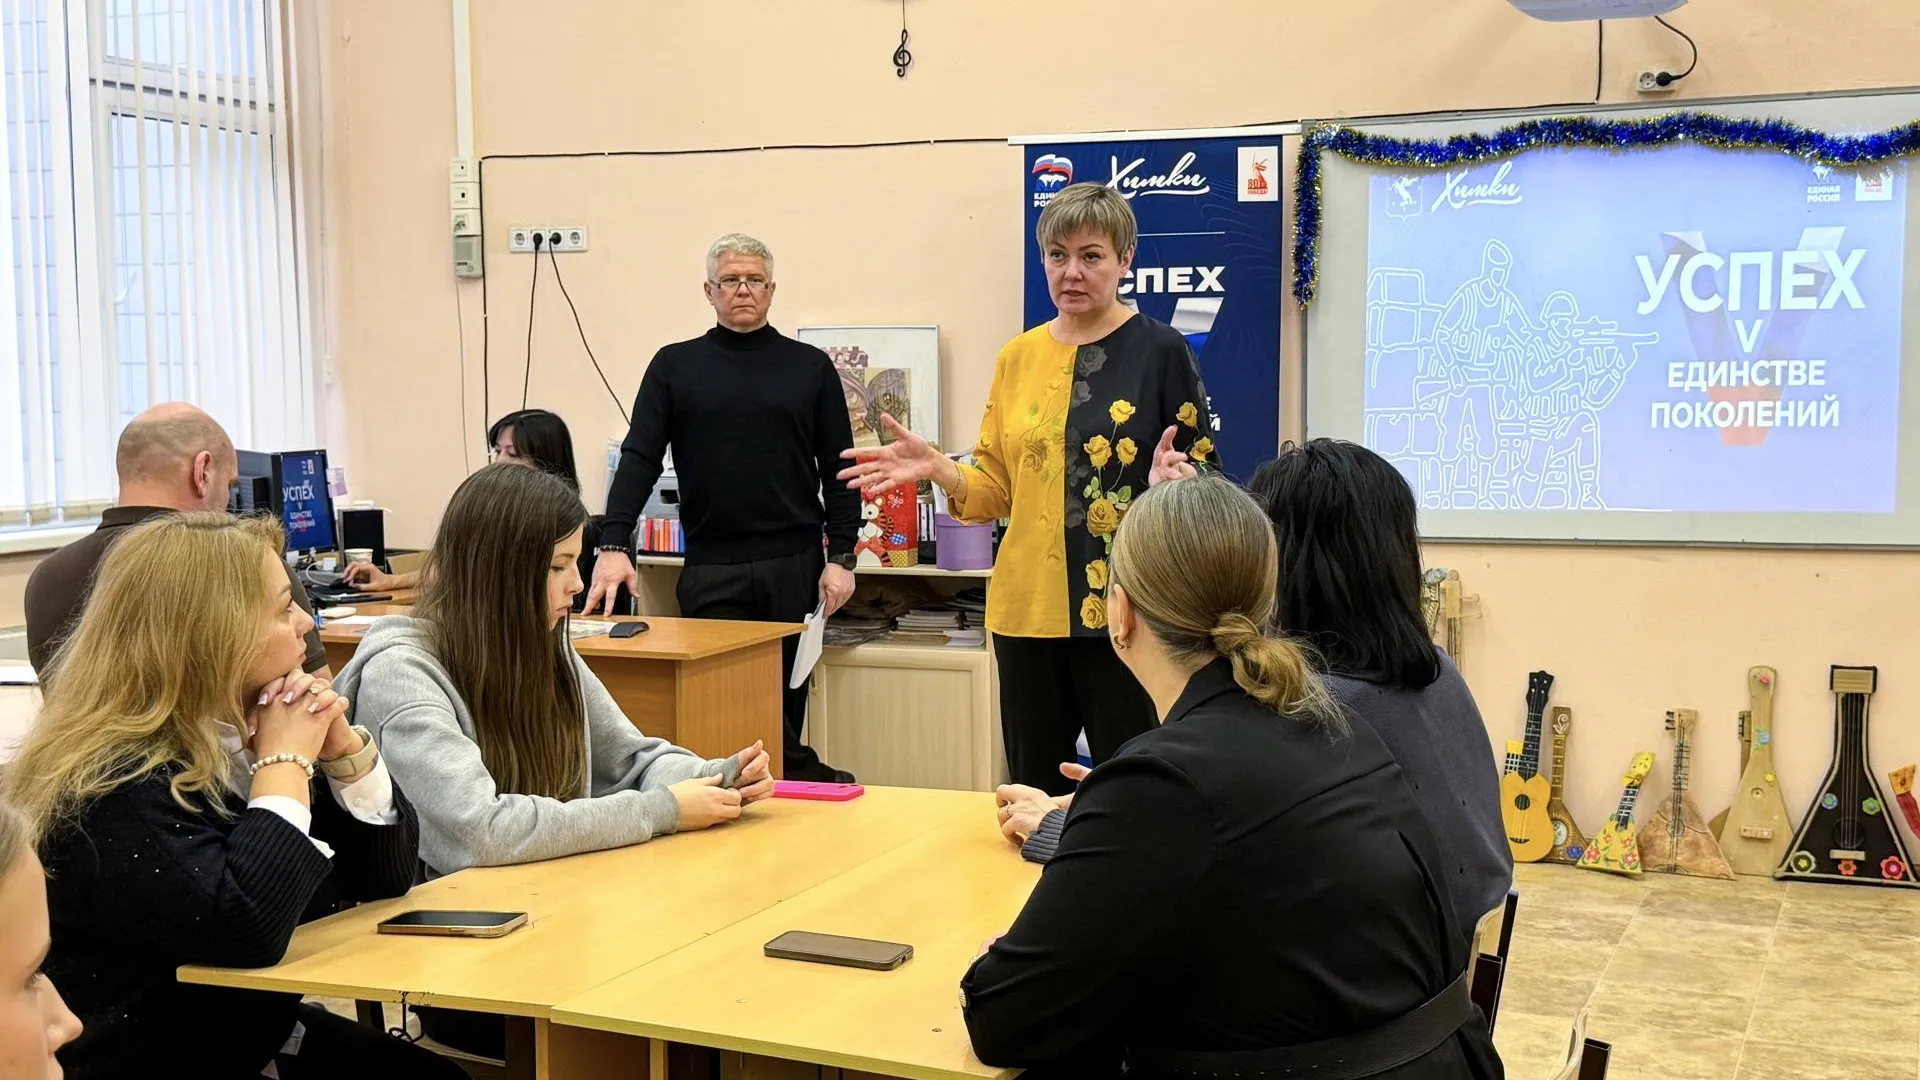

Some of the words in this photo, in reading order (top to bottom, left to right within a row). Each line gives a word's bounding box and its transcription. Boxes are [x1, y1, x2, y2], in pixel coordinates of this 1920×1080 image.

[1103, 152, 1210, 199] Химки
[1431, 160, 1523, 213] Химки
[1806, 194, 1841, 203] РОССИЯ
[1118, 266, 1225, 294] СПЕХ
[1634, 248, 1867, 315] УСПЕХ
[1734, 319, 1763, 353] V
[1667, 360, 1827, 392] ЕДИНСТВЕ
[1650, 394, 1840, 429] ПОКОЛЕНИЙ
[283, 486, 314, 502] УСПЕХ
